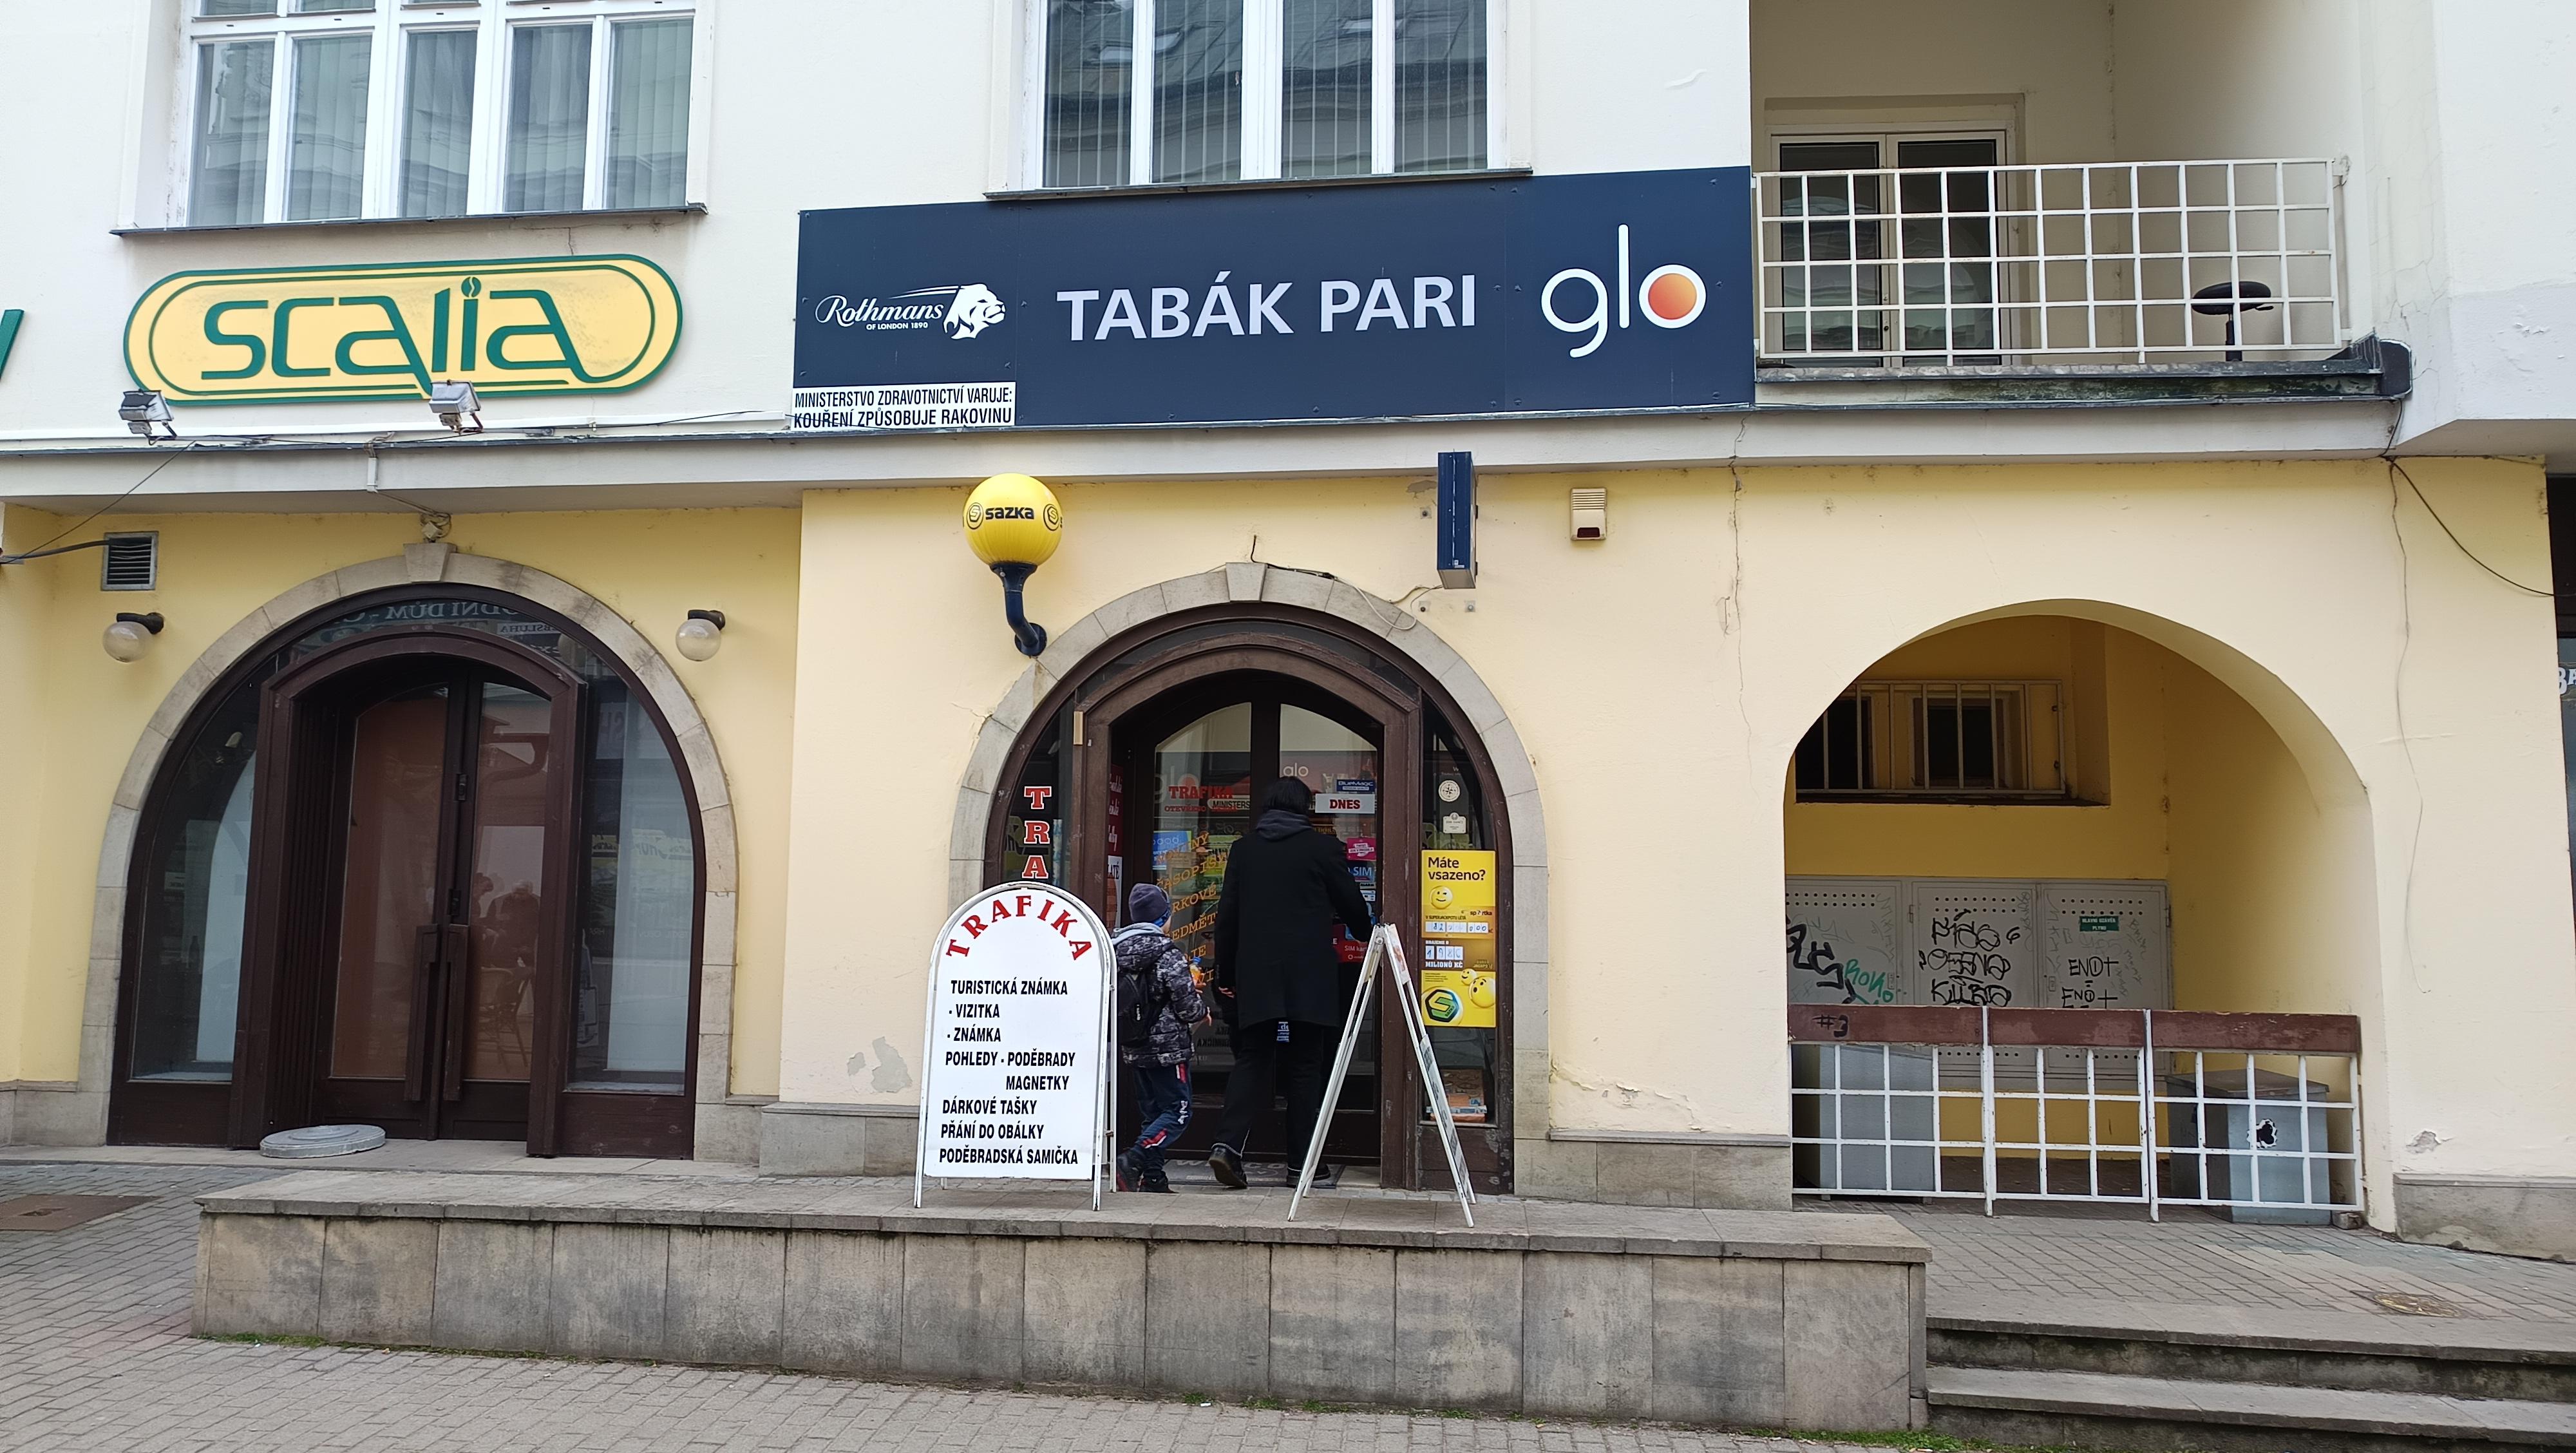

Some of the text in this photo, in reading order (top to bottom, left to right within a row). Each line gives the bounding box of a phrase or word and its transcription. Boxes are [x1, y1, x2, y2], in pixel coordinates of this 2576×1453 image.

[1541, 223, 1707, 358] glo
[815, 294, 944, 327] Rothmans
[1056, 270, 1477, 341] TABÁK PARI
[795, 385, 1013, 408] MINISTERSTVO ZDRAVOTNICTVÍ VARUJE:
[794, 407, 1012, 428] KOUŘENÍ ZPŮSOBUJE RAKOVINU
[1329, 799, 1360, 810] DNES
[1353, 866, 1372, 876] SIM
[1428, 857, 1459, 869] Máte
[1428, 869, 1486, 882] vsazeno?
[945, 895, 1092, 961] TRAFIKA
[951, 976, 1068, 995] TURISTICKÁ ZNÁMKA
[956, 1003, 1000, 1019] VIZITKA
[953, 1024, 1001, 1043] ZNÁMKA
[945, 1051, 998, 1067] POHLEDY
[1007, 1048, 1075, 1067] PODĚBRADY
[1005, 1076, 1069, 1090] MAGNETKY
[942, 1096, 1037, 1115] DÁRKOVÉ TAŠKY
[941, 1120, 1045, 1139] PŘÁNÍ DO OBÁLKY
[940, 1144, 1079, 1165] PODĚBRADSKÁ SAMIČKA
